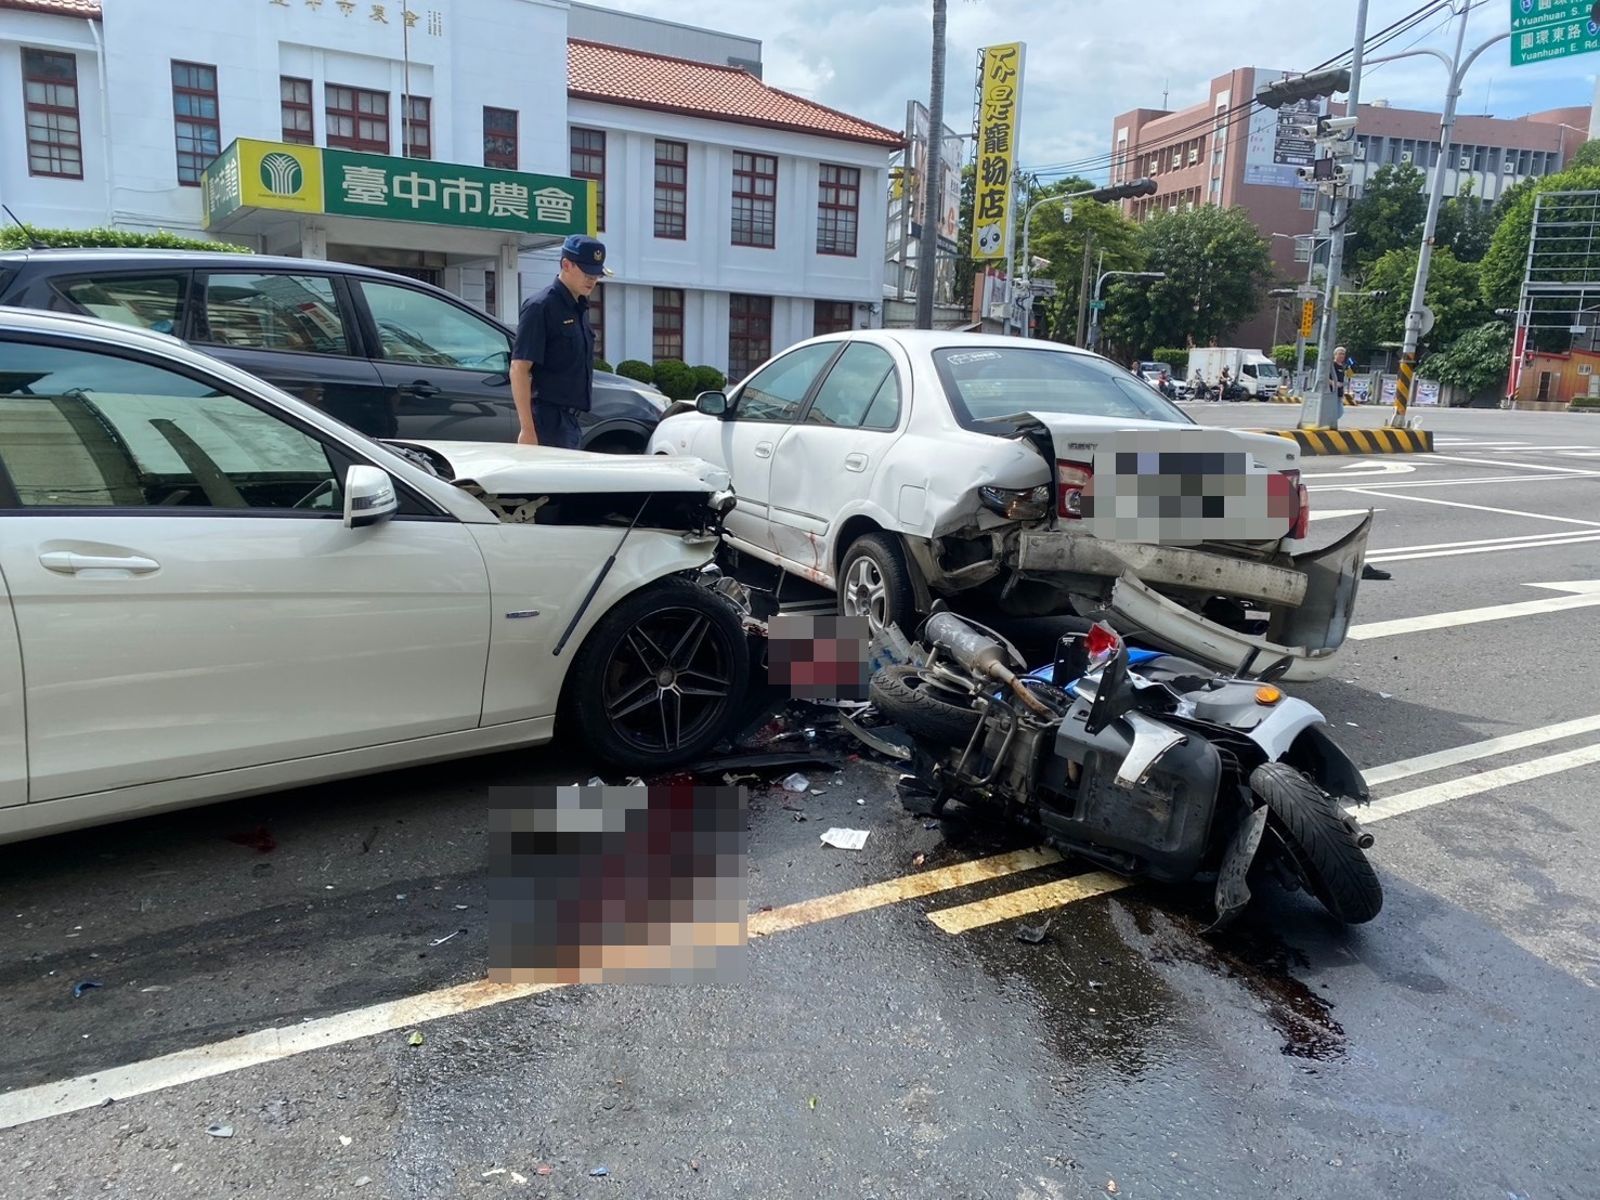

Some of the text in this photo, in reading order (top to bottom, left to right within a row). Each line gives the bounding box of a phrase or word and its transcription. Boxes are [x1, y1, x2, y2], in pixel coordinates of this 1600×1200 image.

[1521, 11, 1566, 26] Yuanhuan
[1520, 24, 1582, 50] 圓環東路
[1521, 47, 1565, 61] Yuanhuan
[342, 165, 575, 225] 臺中市農會
